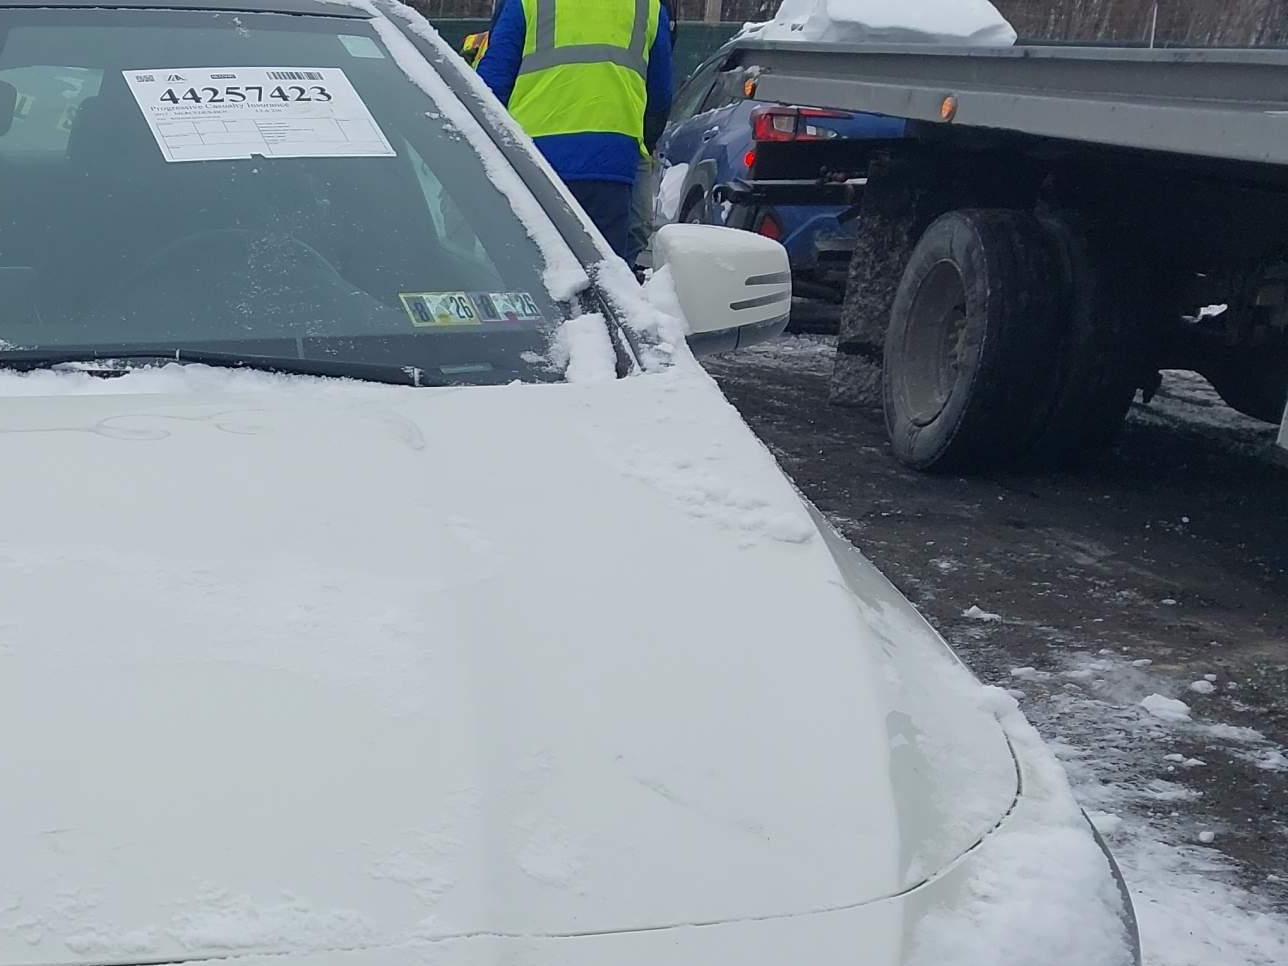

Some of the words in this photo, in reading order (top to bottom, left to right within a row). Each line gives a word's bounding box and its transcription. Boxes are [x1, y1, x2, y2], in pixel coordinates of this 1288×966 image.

[160, 86, 332, 105] 44257423
[150, 104, 203, 112] Progressive
[205, 102, 244, 110] Casualty
[449, 296, 474, 319] 26
